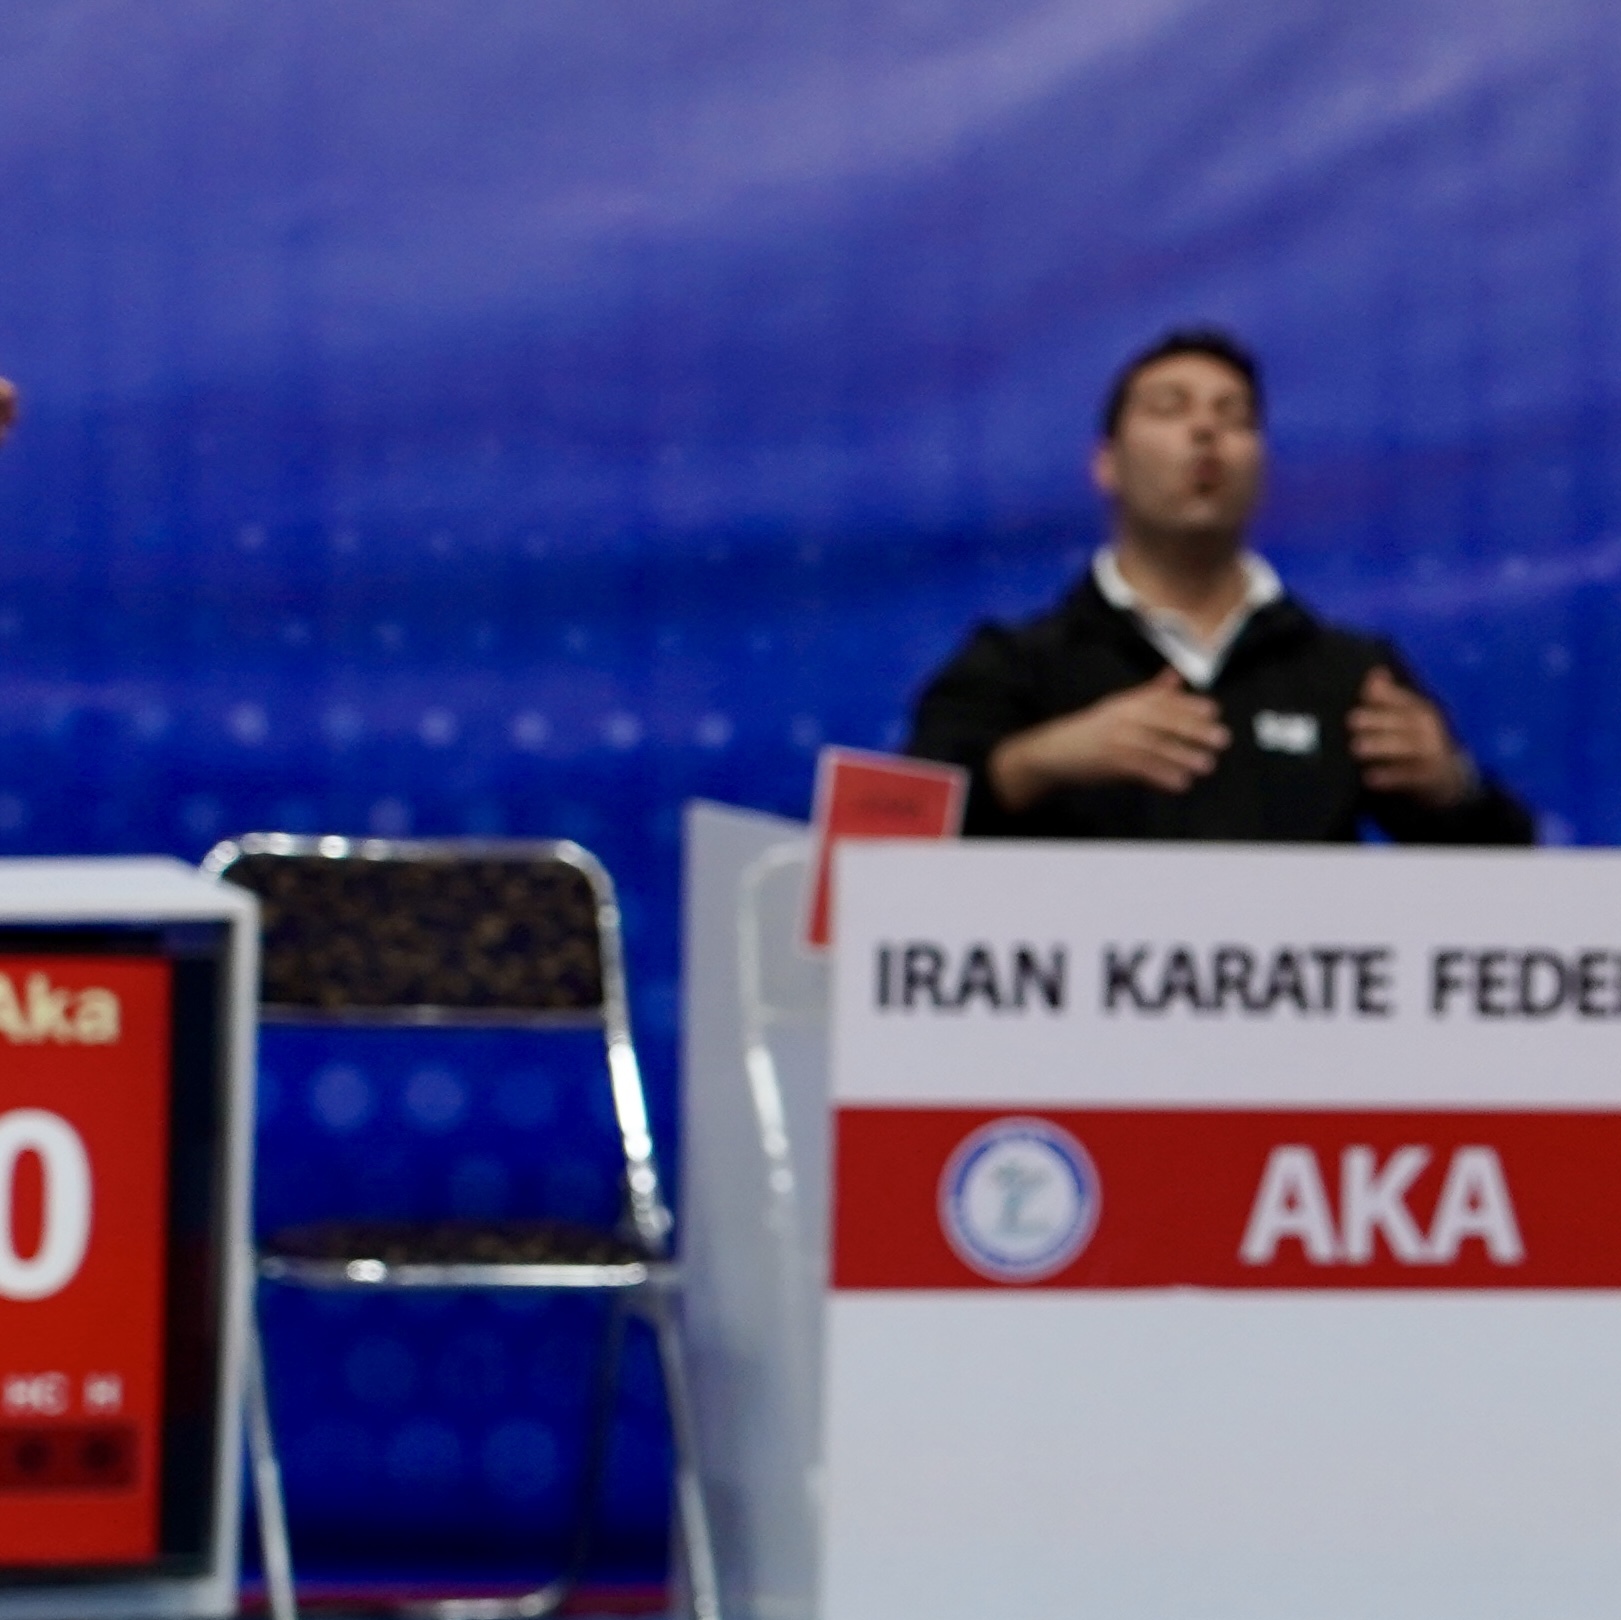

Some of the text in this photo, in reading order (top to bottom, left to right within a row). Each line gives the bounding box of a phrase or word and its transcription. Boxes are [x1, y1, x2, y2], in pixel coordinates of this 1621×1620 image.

[874, 941, 1066, 1014] IRAN
[1103, 944, 1394, 1018] KARATE
[0, 1108, 92, 1300] 0
[1238, 1145, 1524, 1266] AKA
